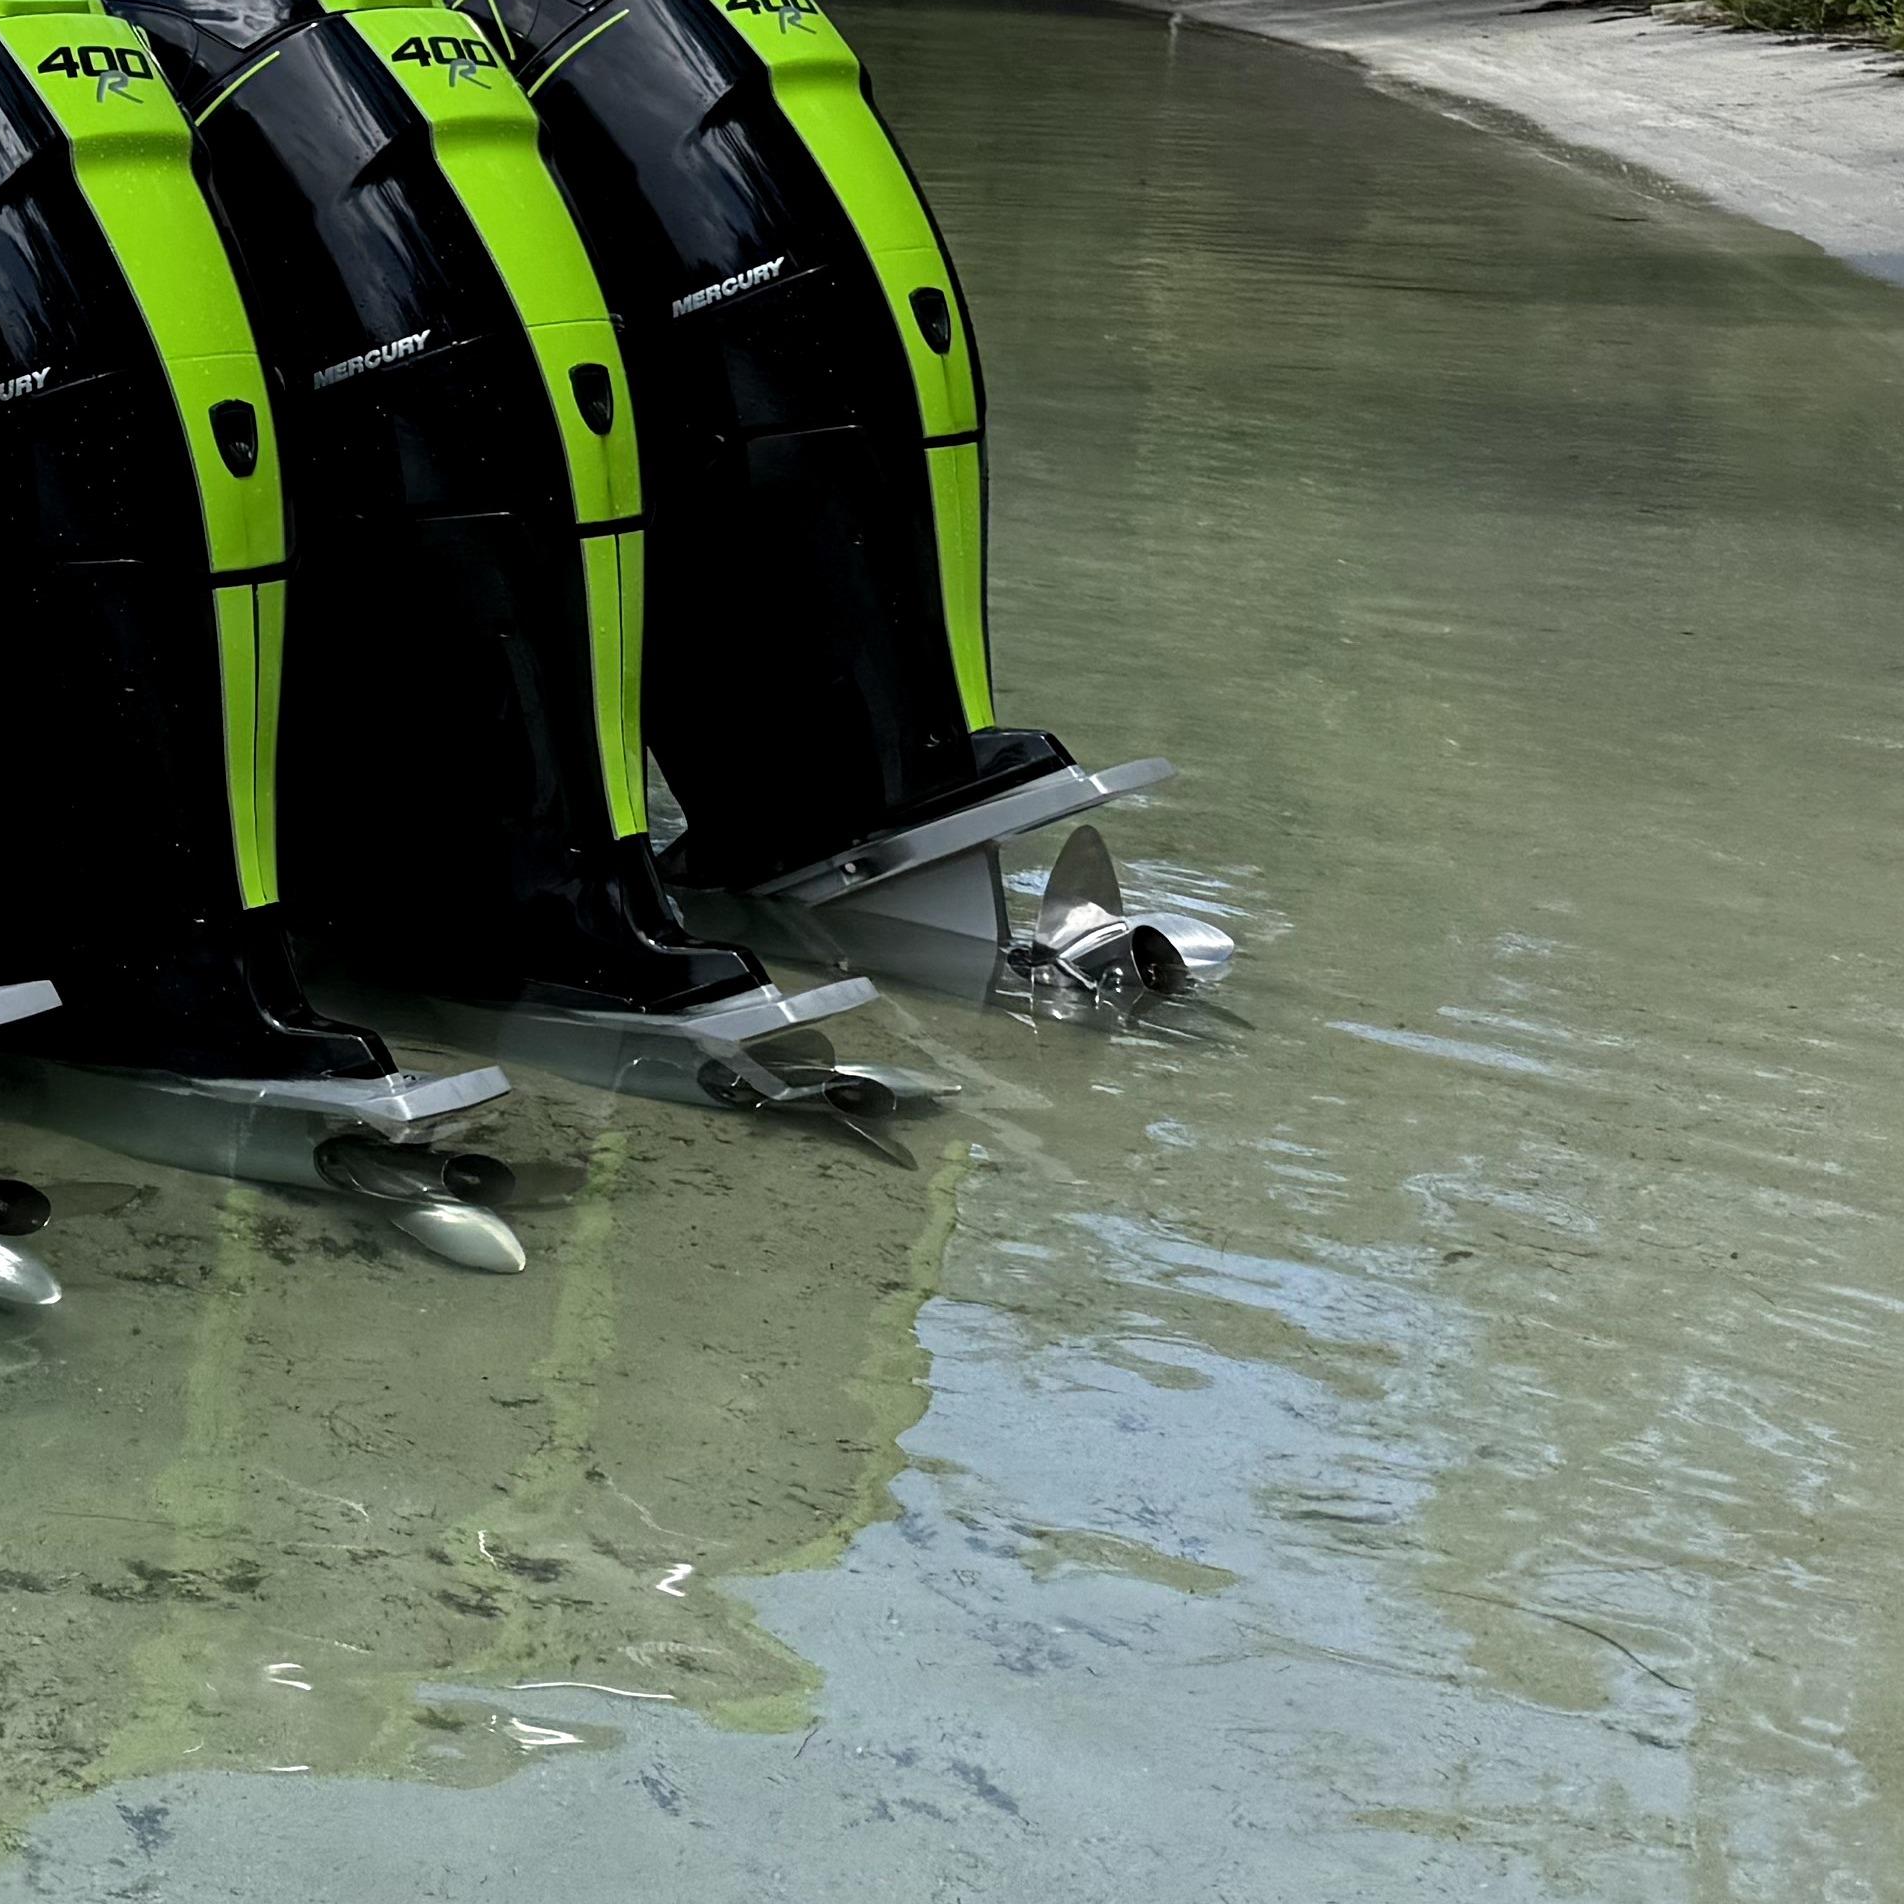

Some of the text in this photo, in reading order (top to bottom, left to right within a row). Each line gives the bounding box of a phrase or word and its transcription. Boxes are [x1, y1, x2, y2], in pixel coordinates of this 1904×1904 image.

[36, 46, 154, 81] 400
[390, 36, 499, 69] 400
[96, 69, 145, 104] R
[672, 256, 785, 319] MERCURY
[313, 329, 432, 390] MERCURY
